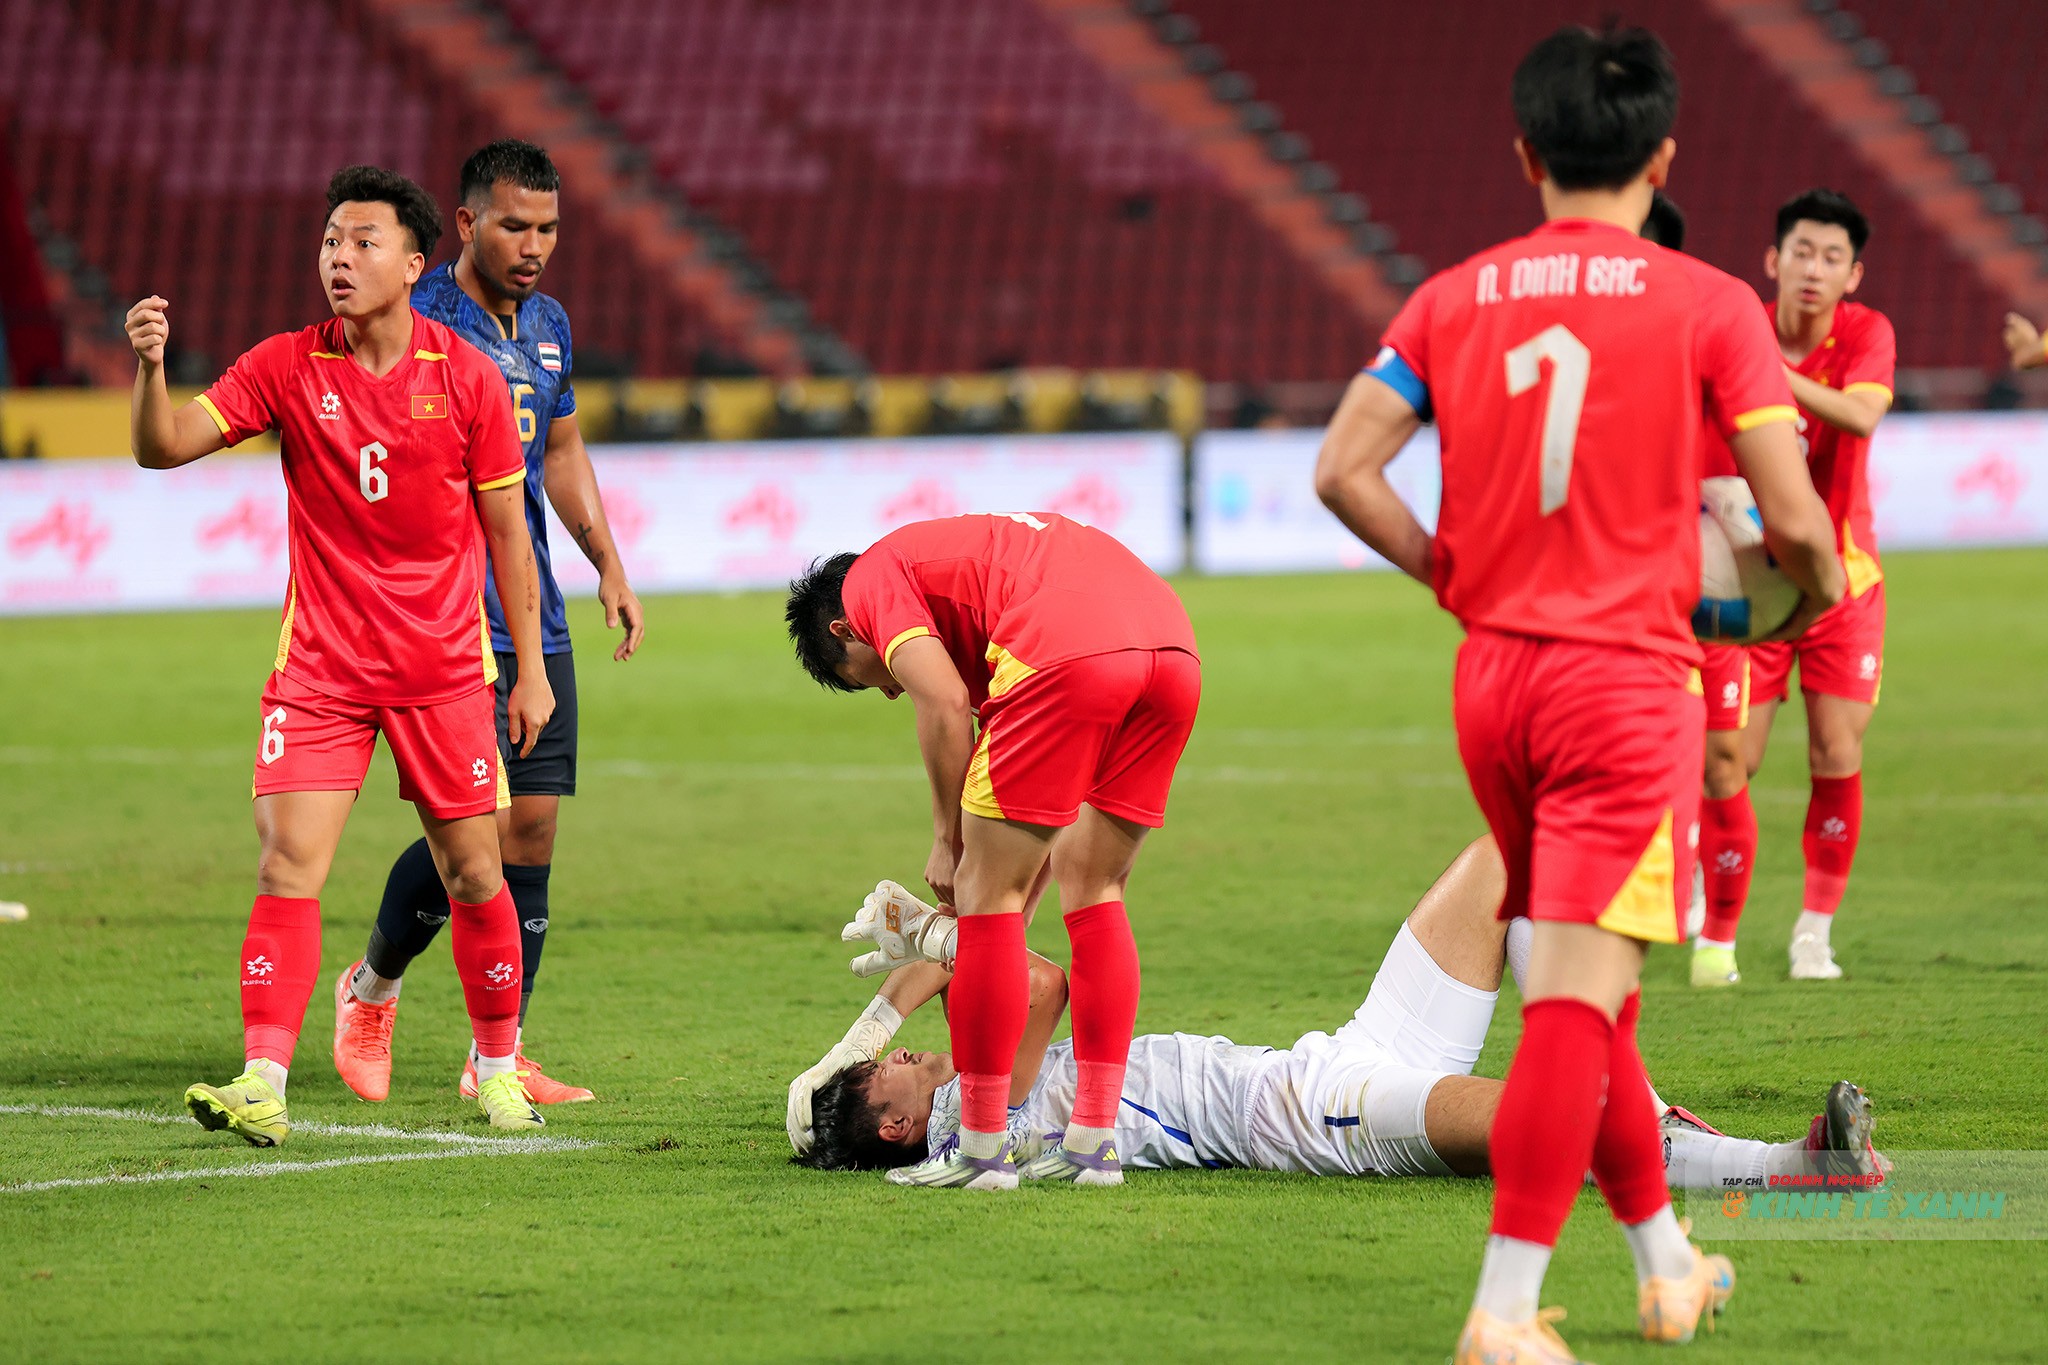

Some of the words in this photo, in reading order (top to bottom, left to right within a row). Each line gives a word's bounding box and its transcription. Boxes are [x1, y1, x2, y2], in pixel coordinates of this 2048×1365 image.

[1504, 322, 1591, 517] 7
[359, 440, 388, 503] 6
[261, 706, 288, 765] 6
